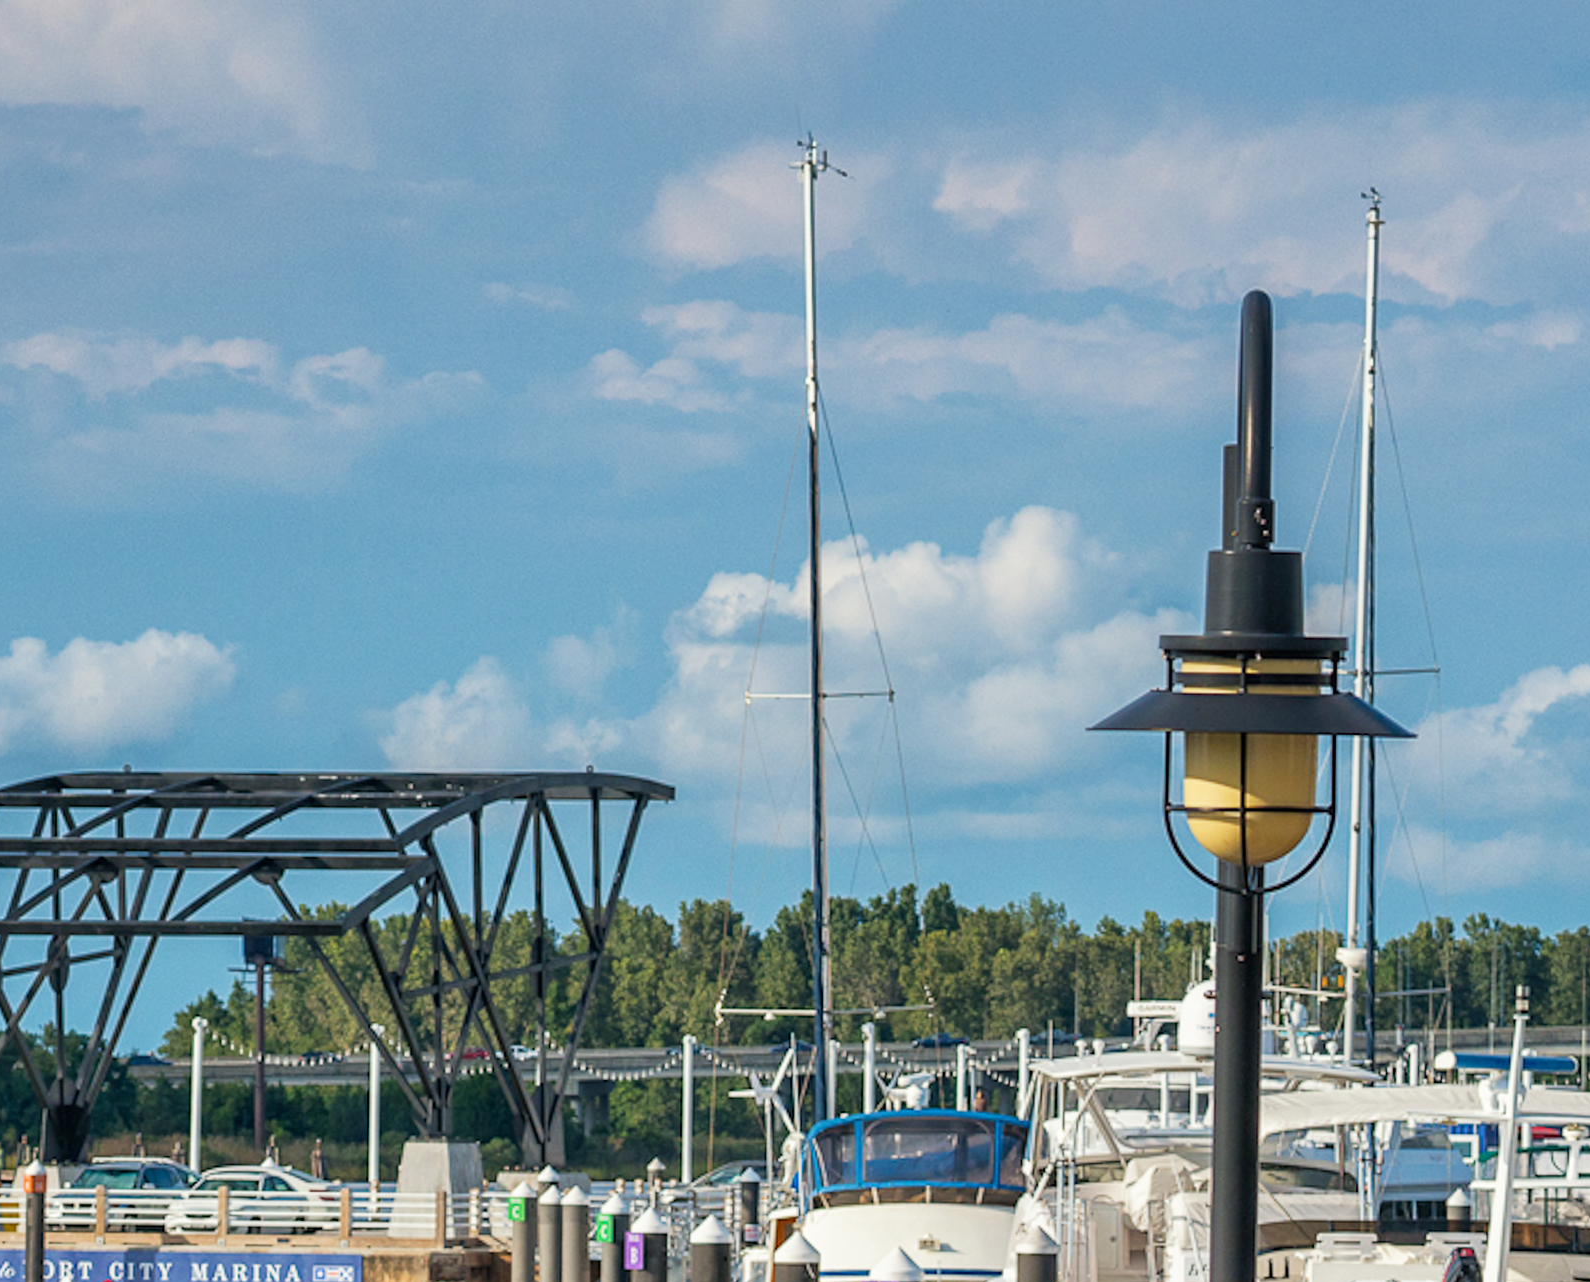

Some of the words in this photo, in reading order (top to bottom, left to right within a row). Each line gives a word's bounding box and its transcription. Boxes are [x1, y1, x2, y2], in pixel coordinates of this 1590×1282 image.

[512, 1206, 520, 1218] C
[601, 1225, 608, 1238] C
[630, 1247, 639, 1264] B
[109, 1261, 173, 1282] CITY
